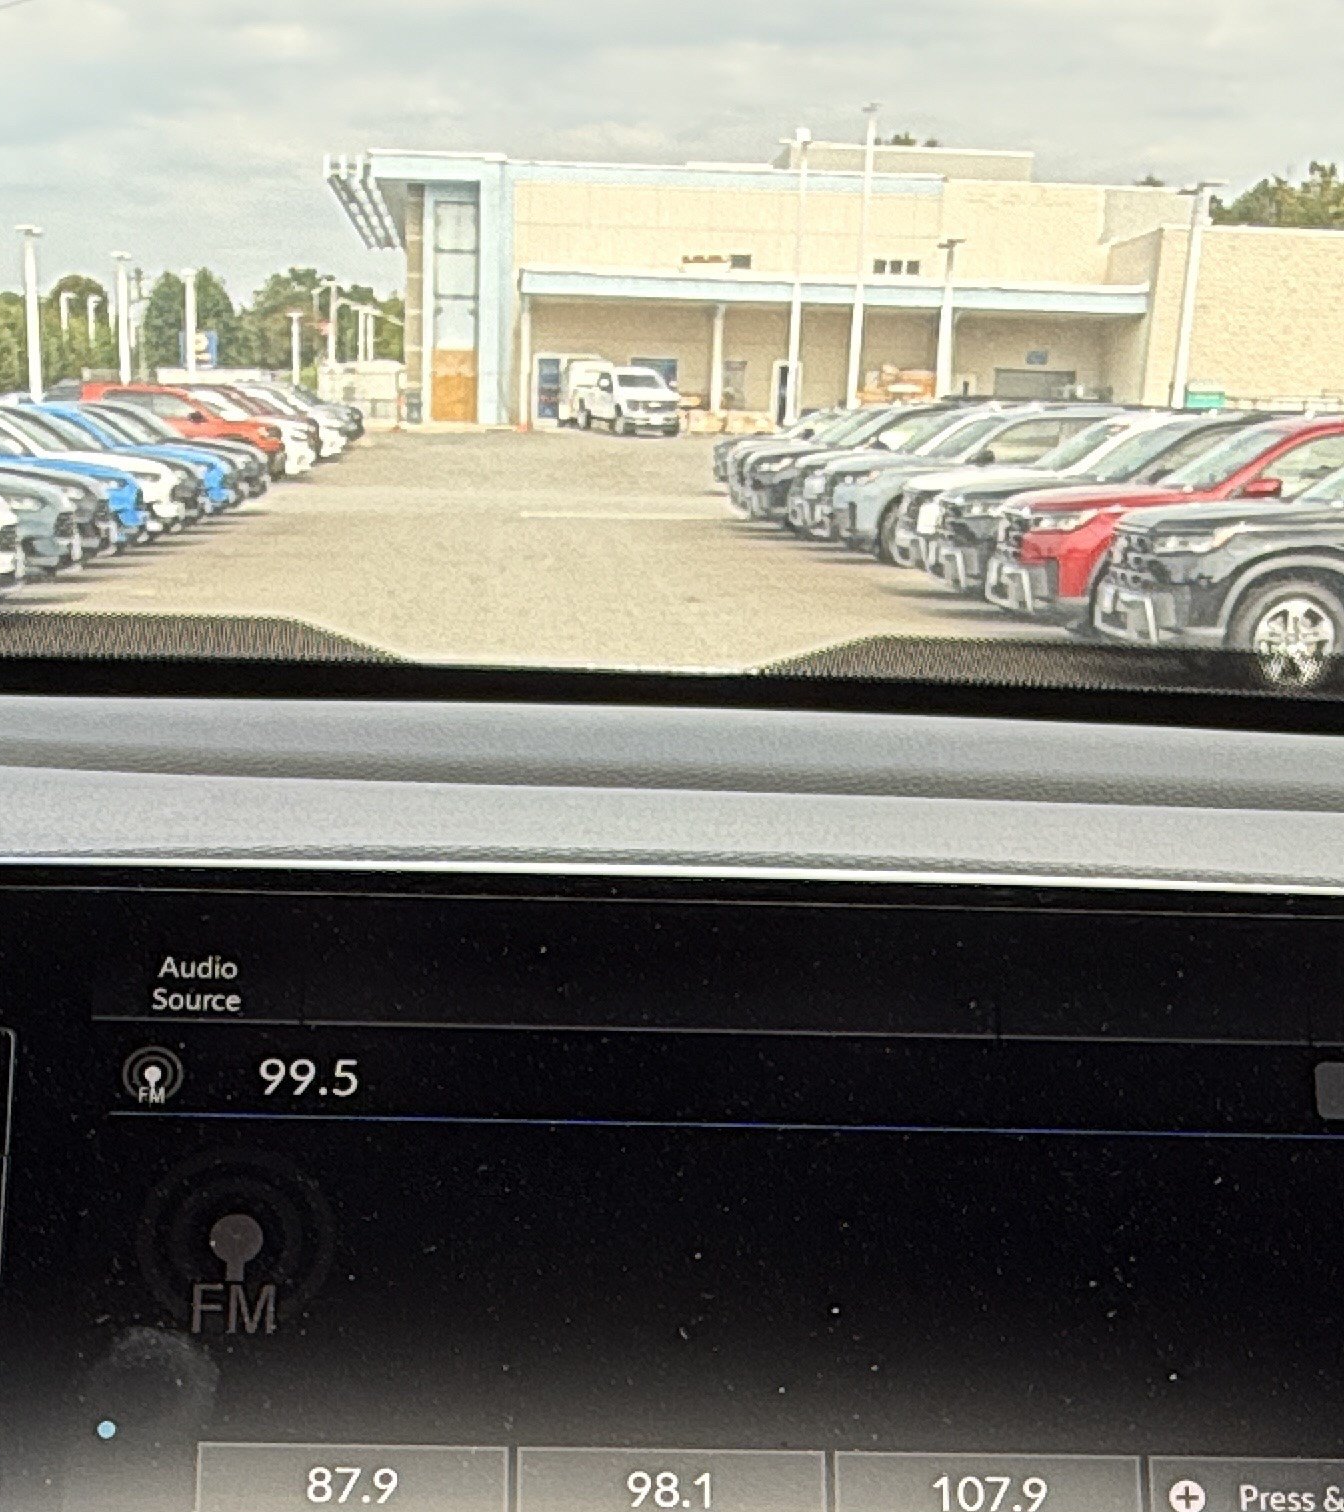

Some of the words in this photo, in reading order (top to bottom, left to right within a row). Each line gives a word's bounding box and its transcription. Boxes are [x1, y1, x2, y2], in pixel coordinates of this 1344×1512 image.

[157, 955, 238, 980] Audio
[152, 986, 242, 1012] Source
[259, 1058, 358, 1097] 99.5
[138, 1087, 166, 1104] FM
[191, 1285, 278, 1335] FM
[306, 1466, 398, 1504] 87.9
[626, 1470, 711, 1509] 98.1
[1239, 1484, 1316, 1512] Press
